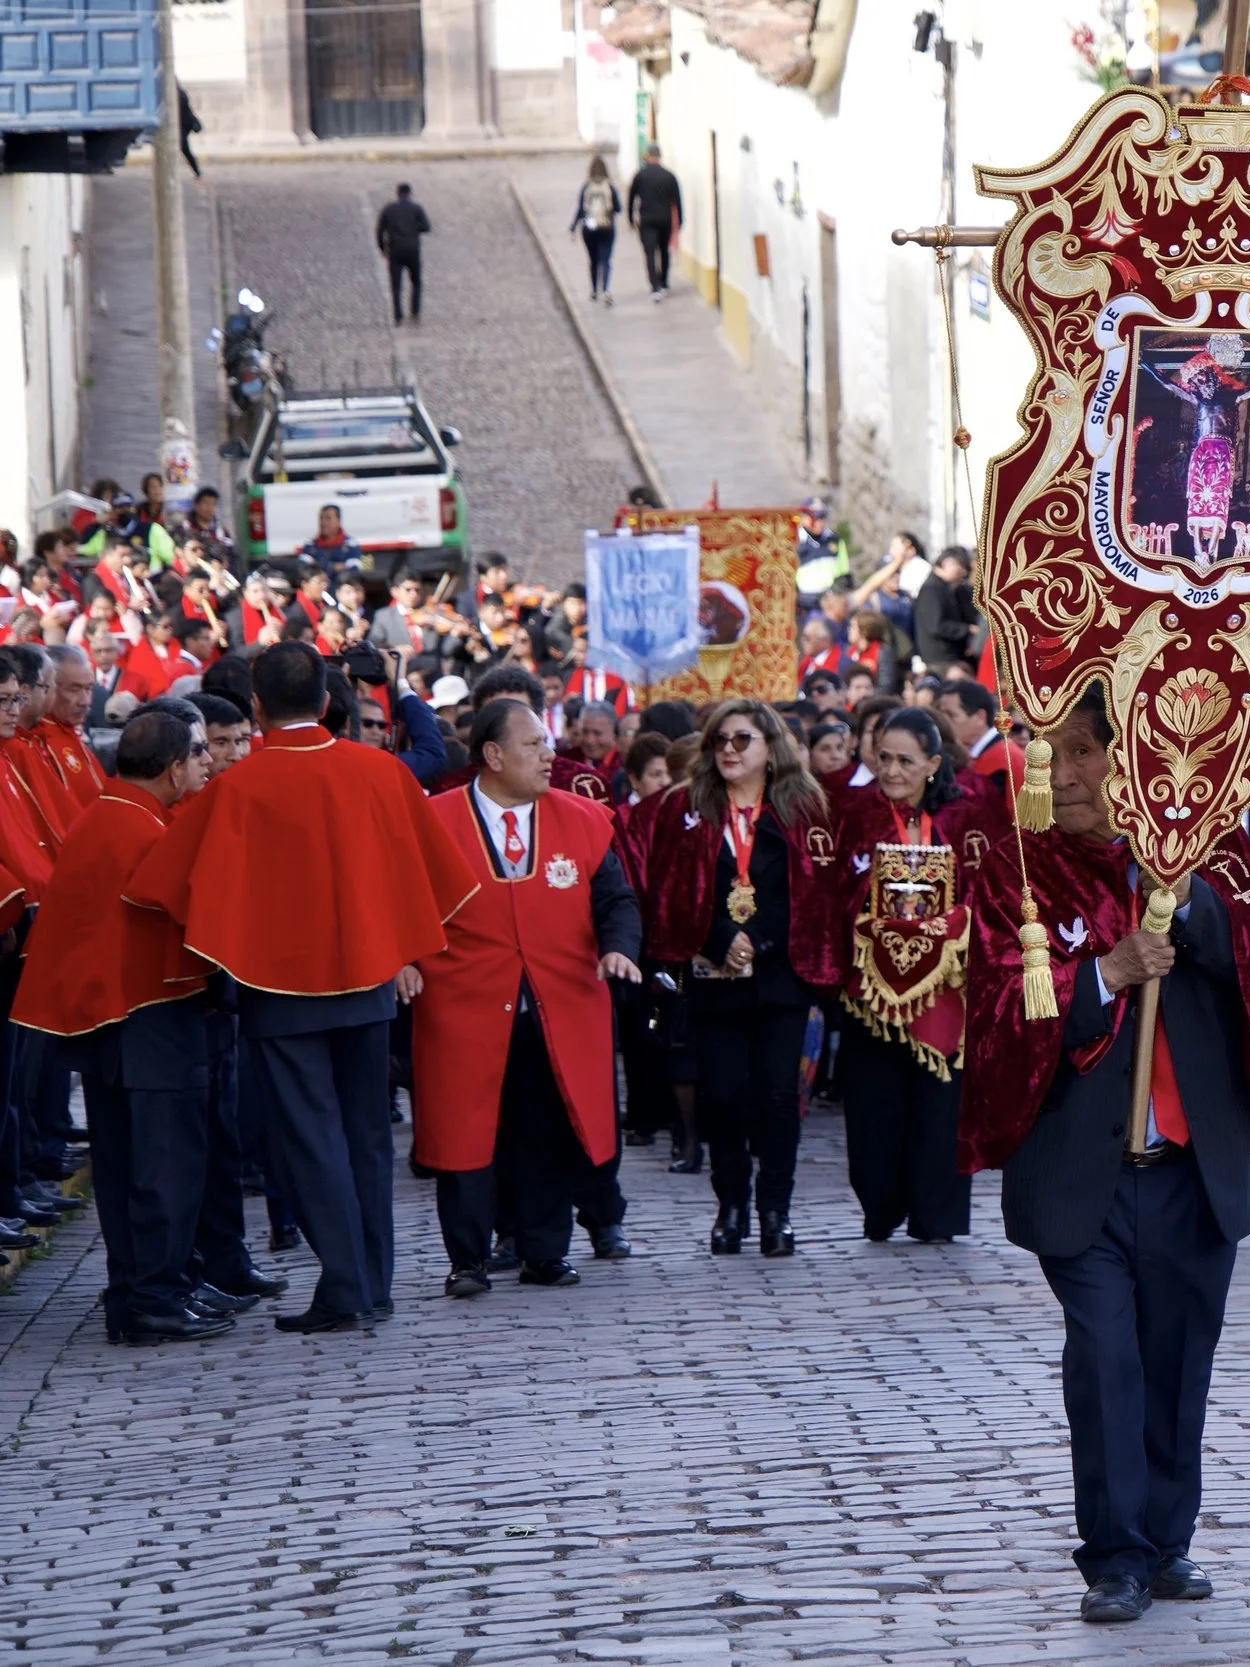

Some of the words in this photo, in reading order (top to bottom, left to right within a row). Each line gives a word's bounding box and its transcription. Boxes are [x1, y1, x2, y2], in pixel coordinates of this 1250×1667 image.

[1101, 307, 1120, 331] DE
[1091, 369, 1120, 425] SEÑOR
[1094, 471, 1139, 582] MAYORDOMIA
[1183, 588, 1219, 604] 2026
